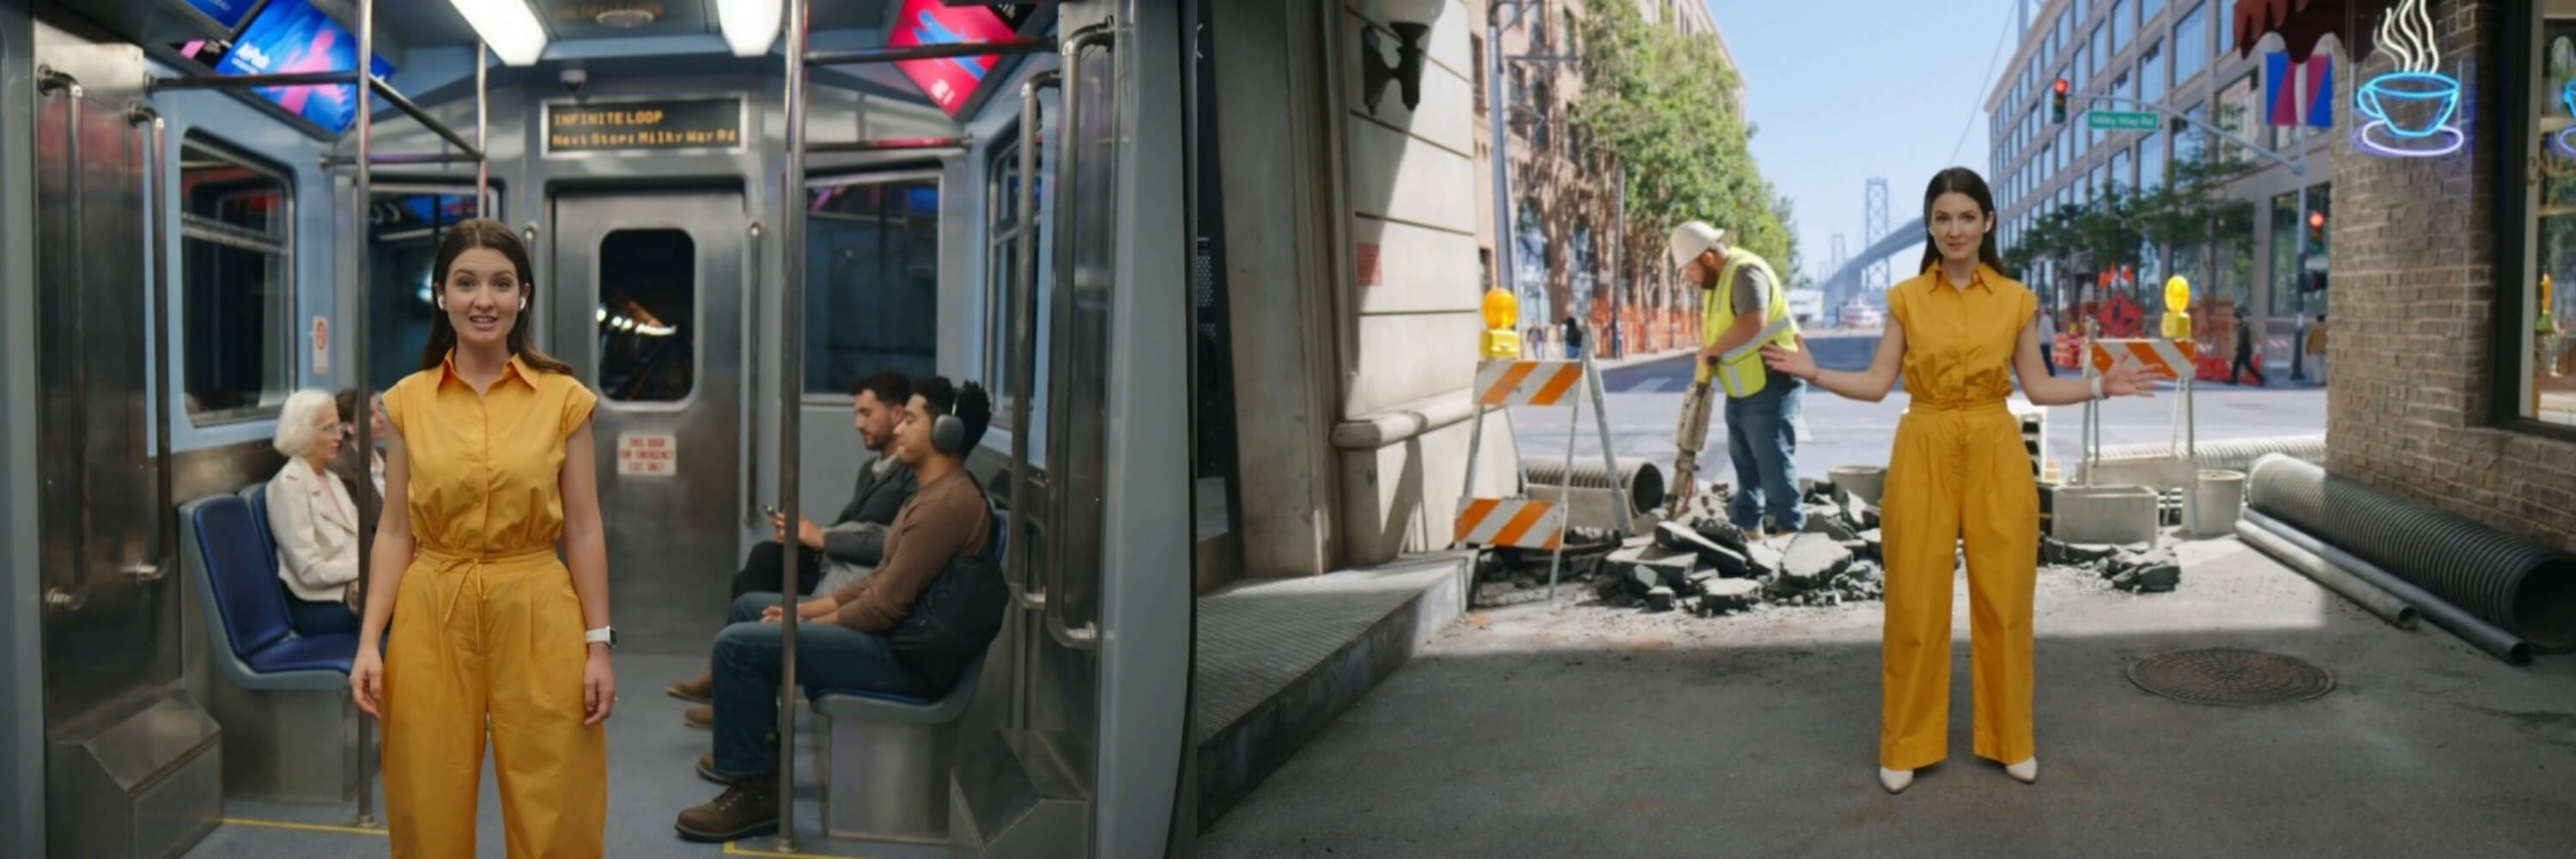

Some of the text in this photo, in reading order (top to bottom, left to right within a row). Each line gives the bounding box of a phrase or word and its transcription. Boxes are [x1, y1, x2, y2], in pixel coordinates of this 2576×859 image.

[554, 110, 664, 126] INFINITE LOOP
[2092, 115, 2116, 126] Milky
[2118, 116, 2138, 126] Way
[552, 133, 587, 146] Next
[639, 131, 683, 145] Milky
[686, 130, 714, 143] Way
[717, 129, 737, 143] Rd
